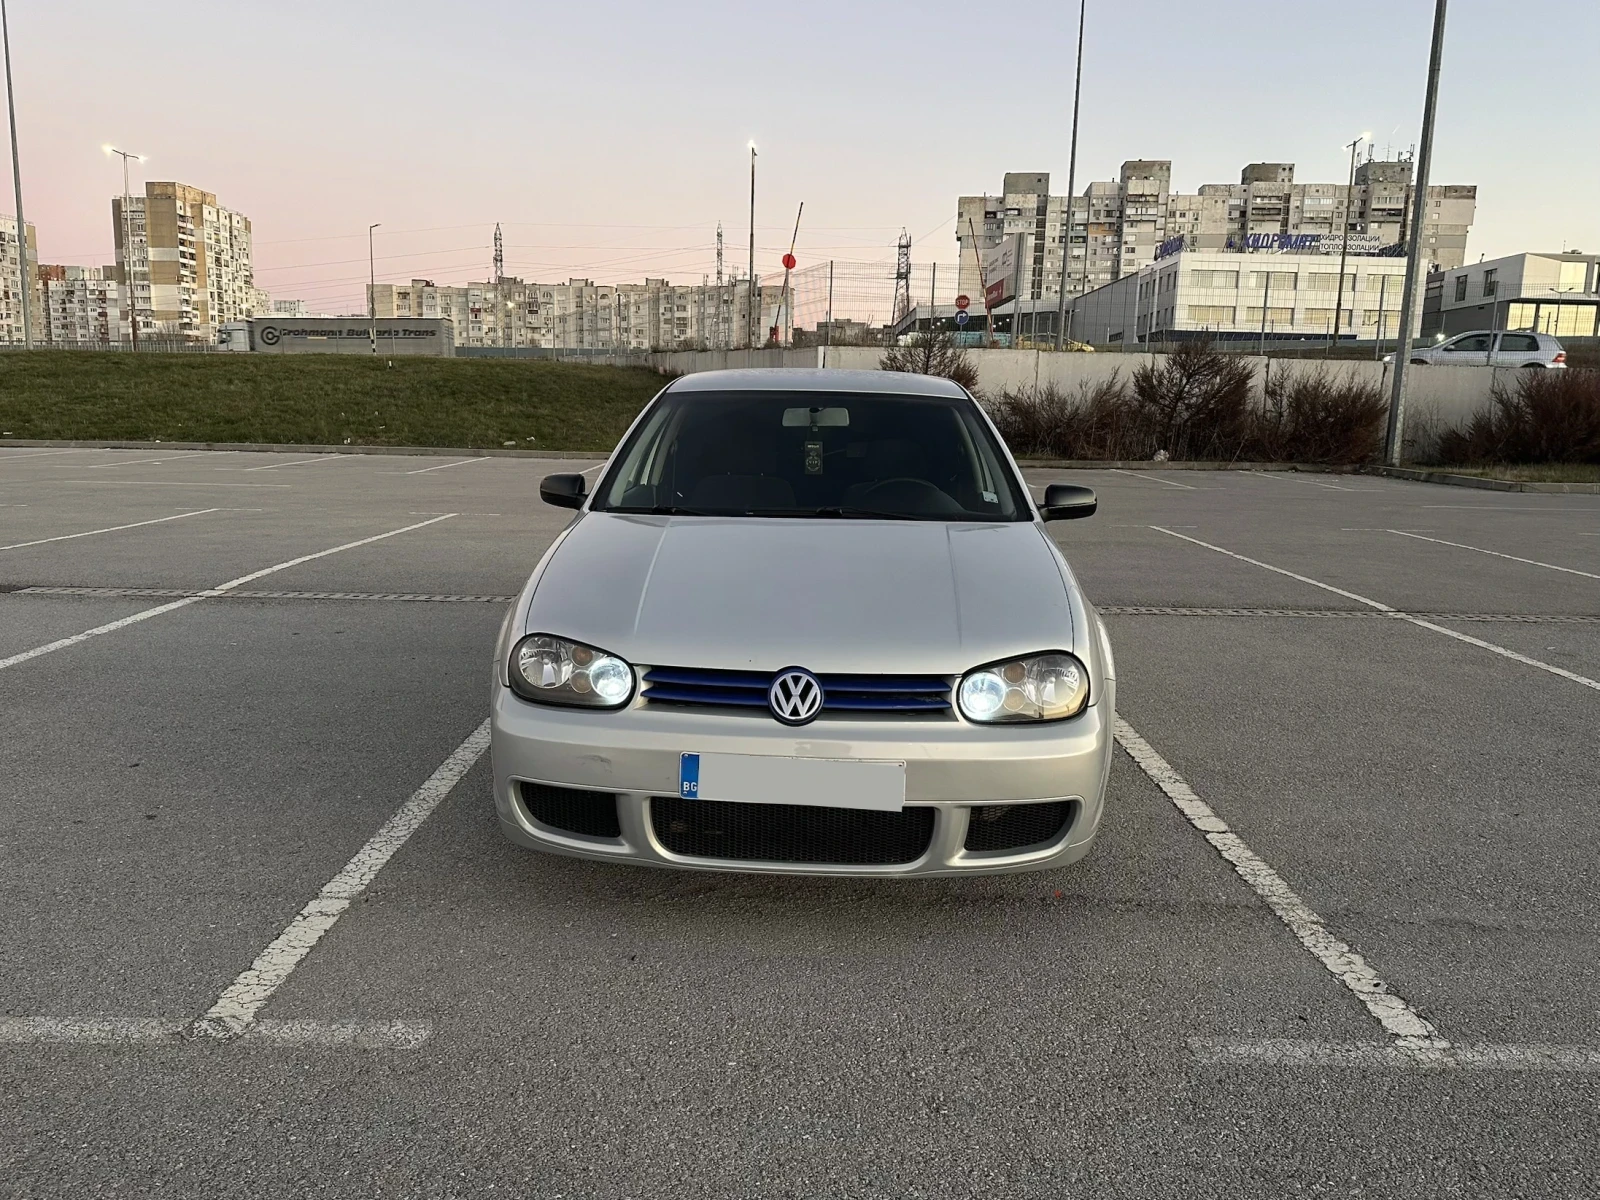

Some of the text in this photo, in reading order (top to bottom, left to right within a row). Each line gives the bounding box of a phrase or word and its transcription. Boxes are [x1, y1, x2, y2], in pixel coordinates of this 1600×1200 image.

[1320, 233, 1380, 243] ХИДРОЗОЛАЦИИ
[1320, 243, 1380, 251] ТОПЛОЗОЛАЦИИ
[402, 329, 437, 337] Trans
[683, 781, 698, 792] BG
